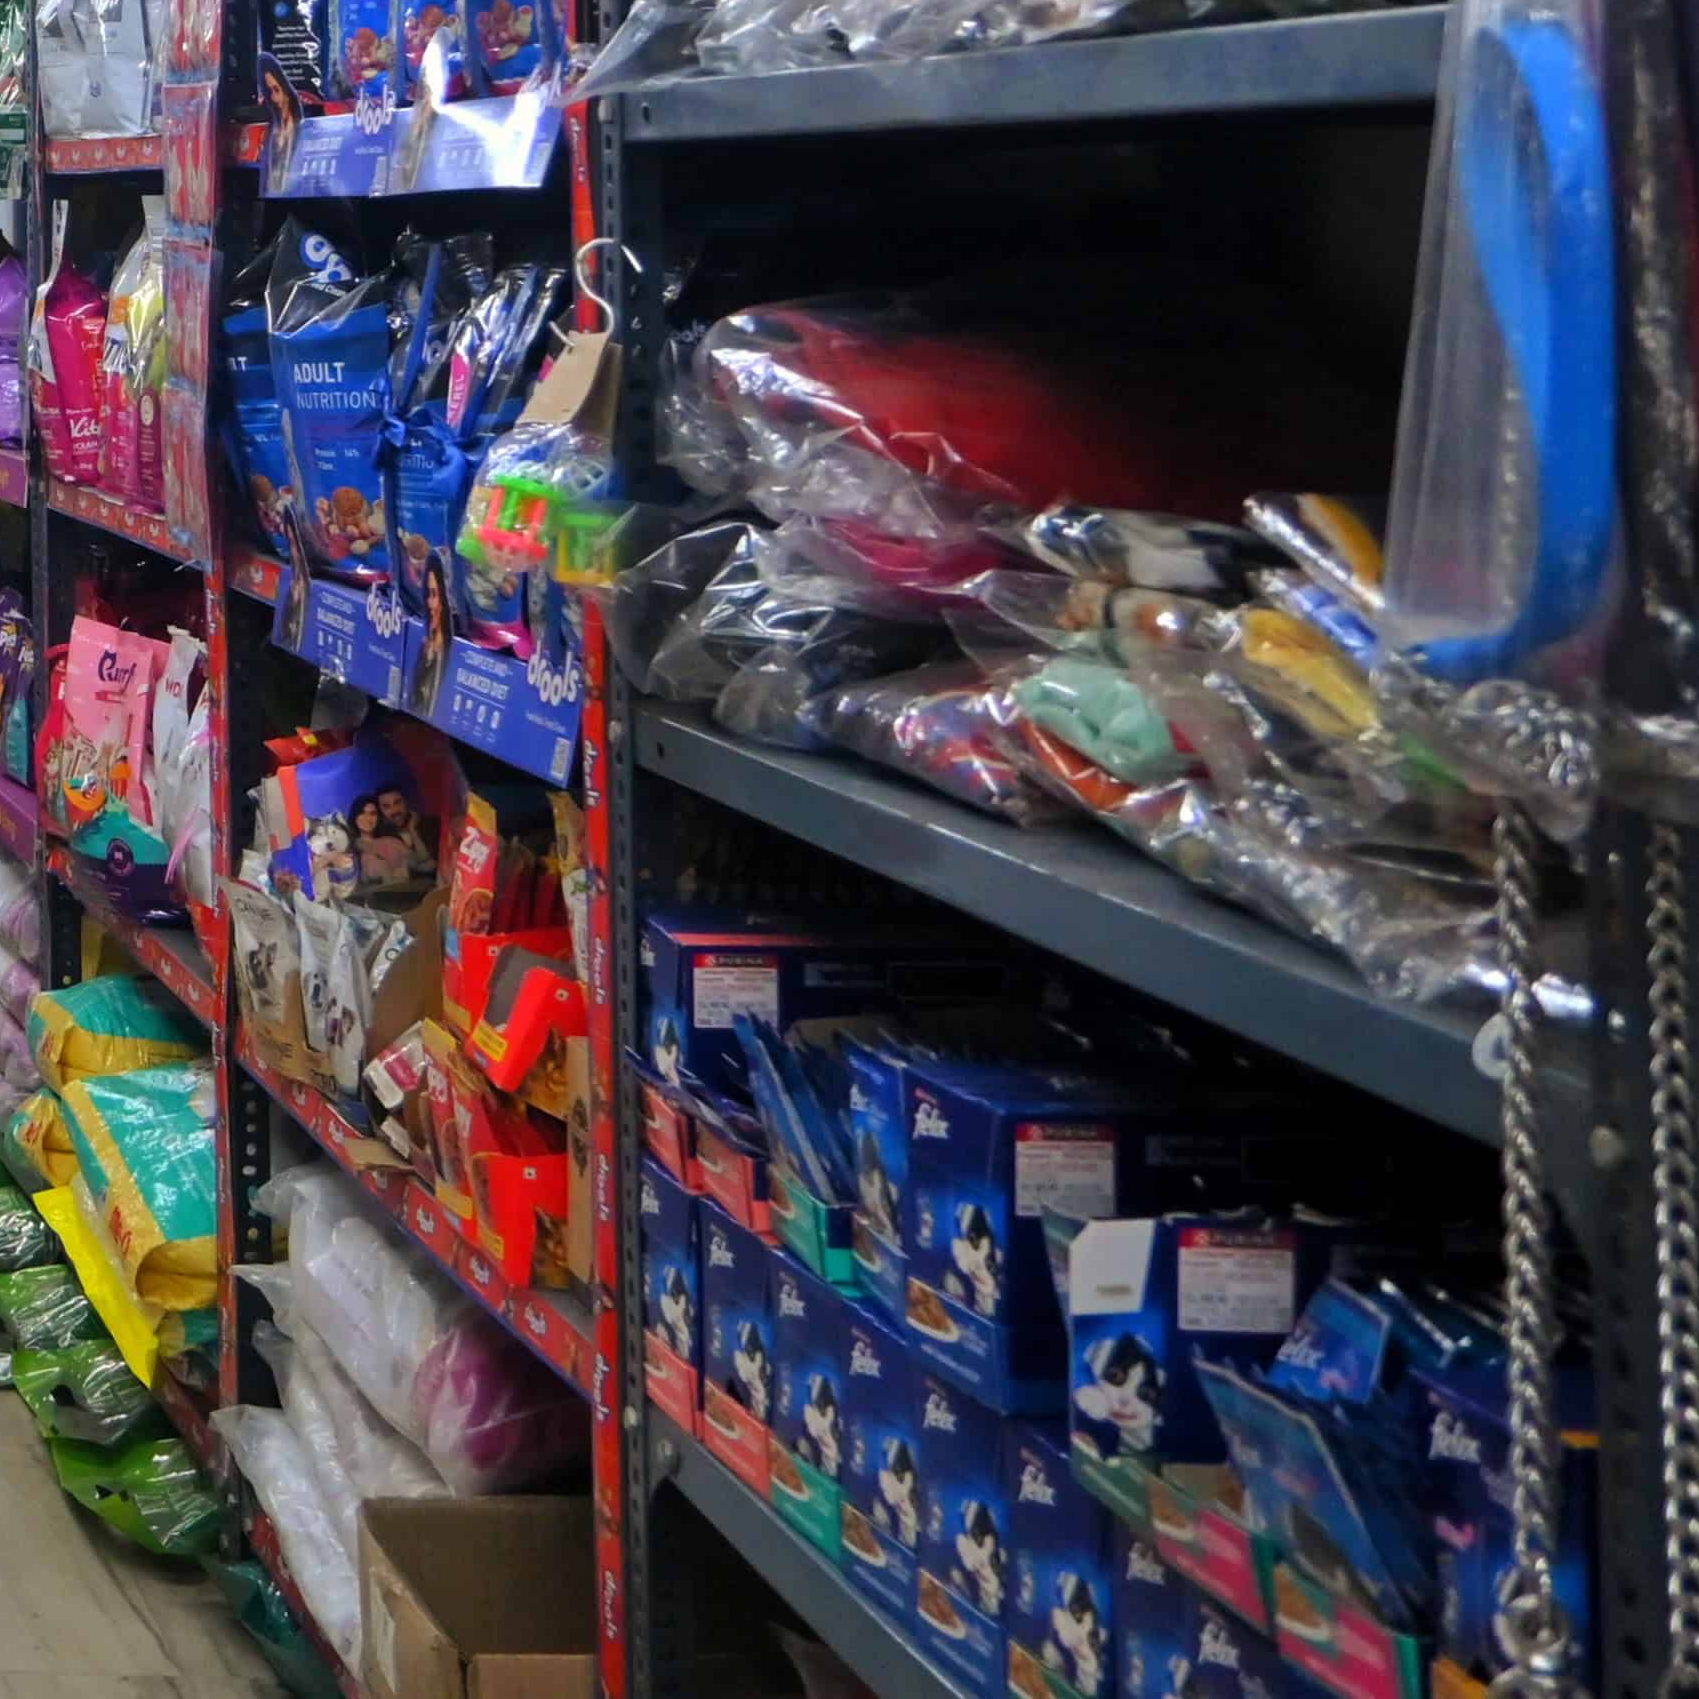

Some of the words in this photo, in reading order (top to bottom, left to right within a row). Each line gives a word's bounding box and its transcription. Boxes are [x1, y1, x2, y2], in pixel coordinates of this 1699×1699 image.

[293, 361, 346, 385] ADULT
[296, 389, 376, 411] NUTRITION
[366, 579, 402, 638] drools
[527, 640, 578, 706] drools
[1427, 1410, 1481, 1464] felix
